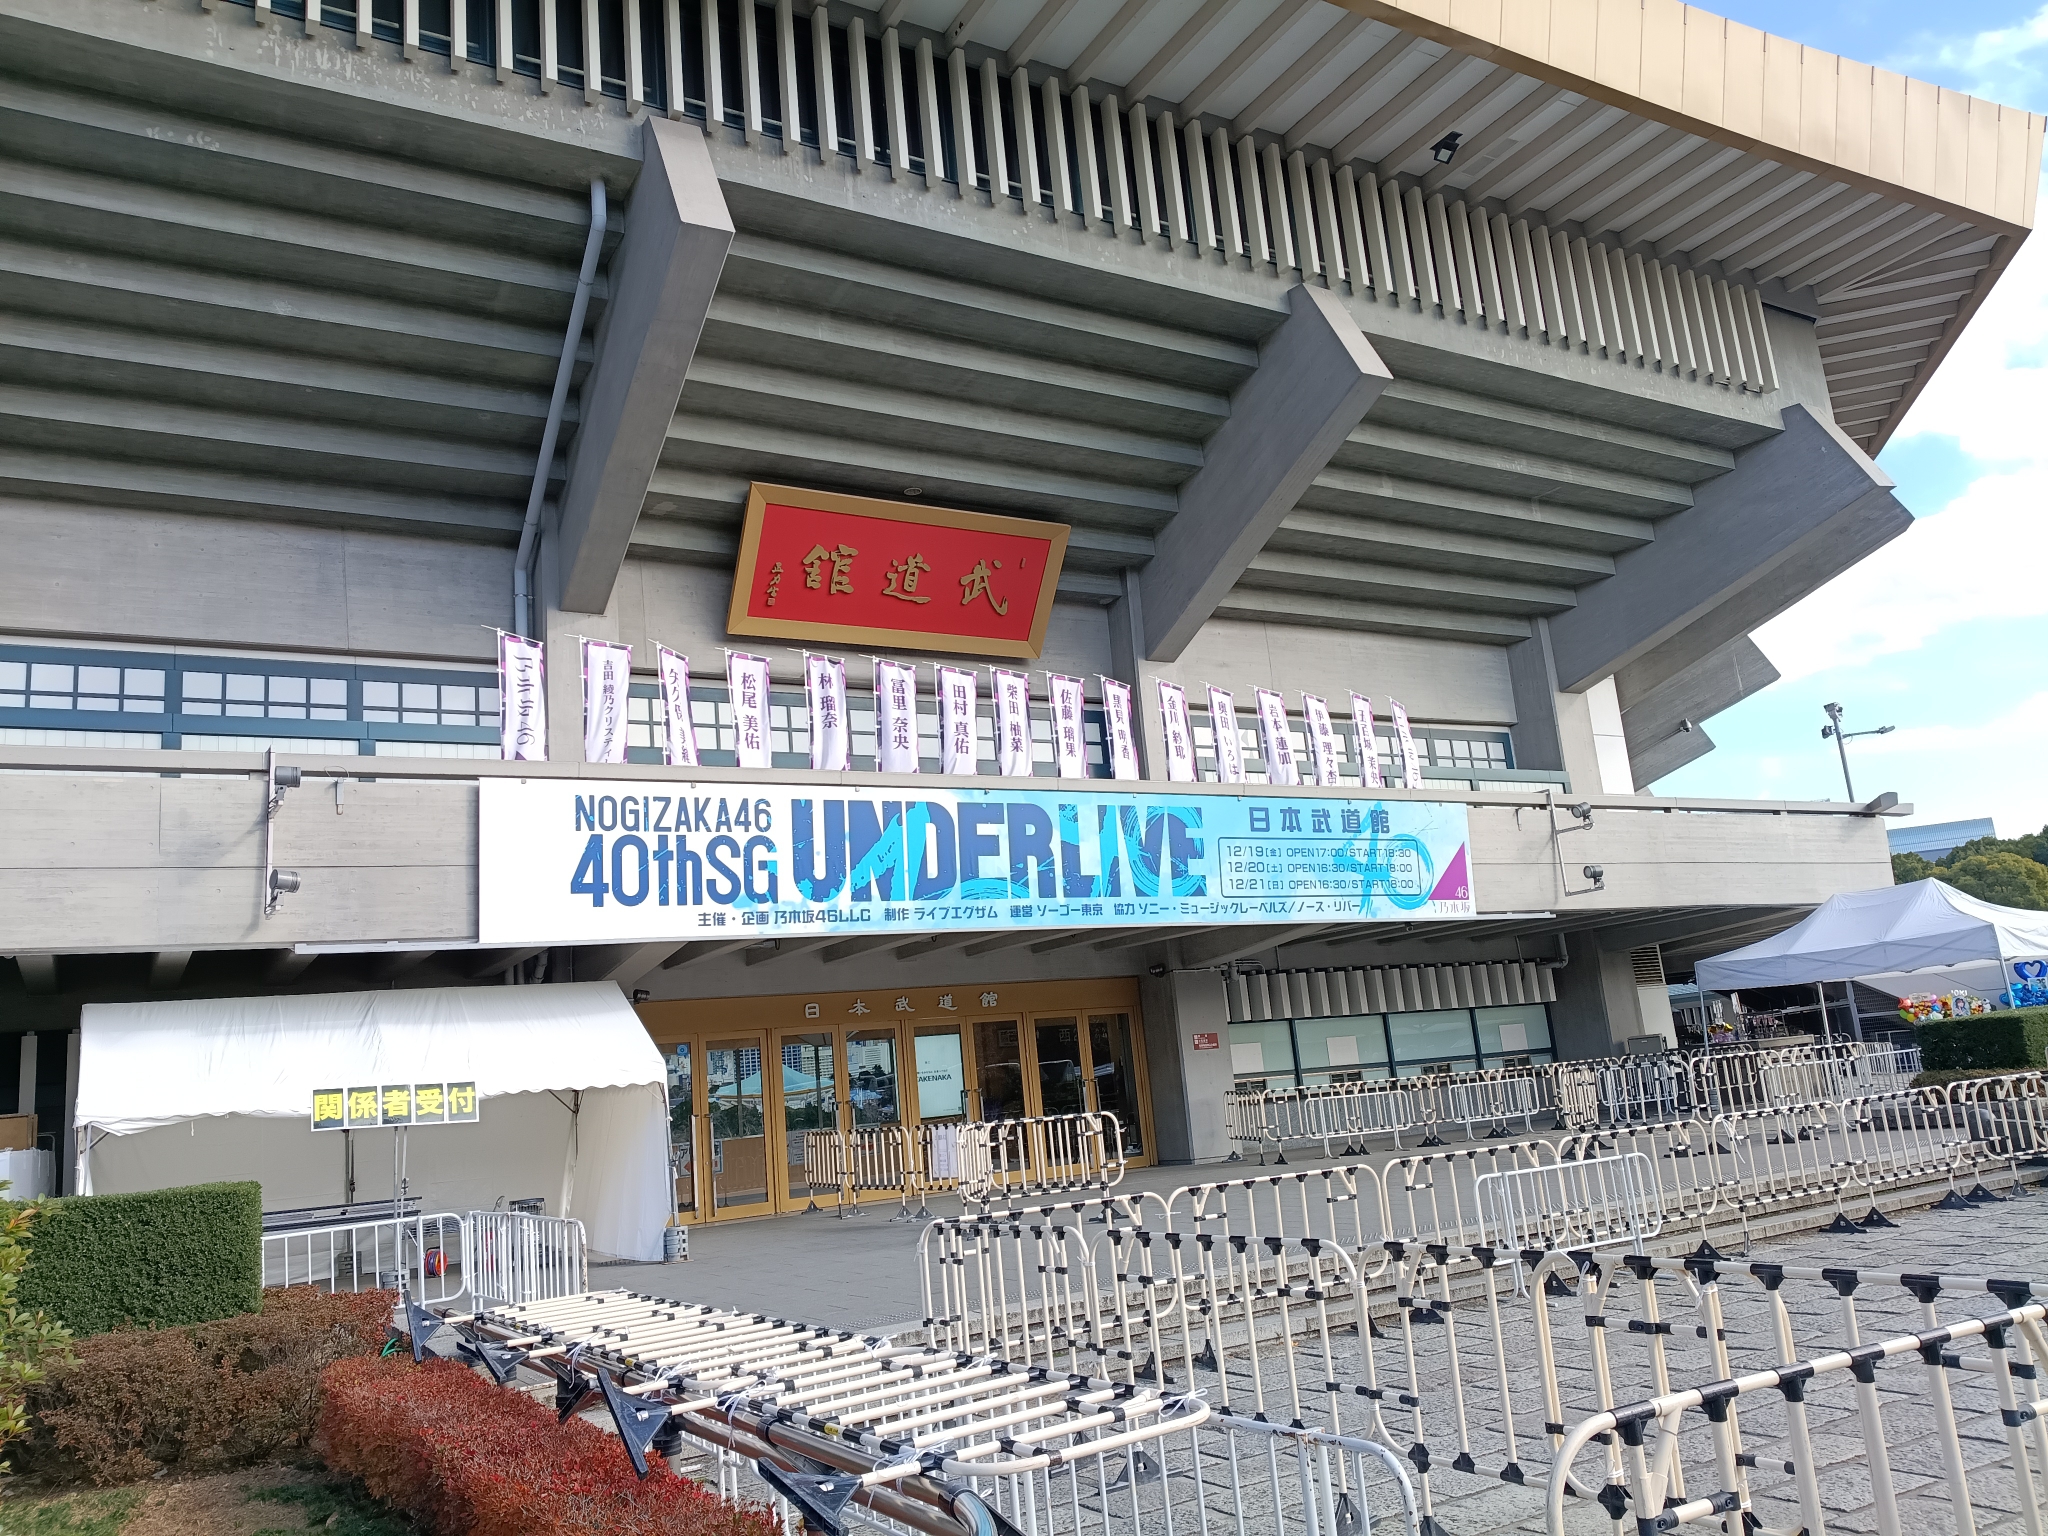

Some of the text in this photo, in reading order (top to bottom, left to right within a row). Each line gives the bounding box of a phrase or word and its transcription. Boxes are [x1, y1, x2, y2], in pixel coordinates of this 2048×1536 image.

[803, 544, 1008, 616] 武道館
[741, 672, 760, 750] 松尾 美佑
[818, 673, 838, 729] 林 瑠奈
[953, 684, 969, 754] 田村 真佑
[1007, 684, 1023, 752] 柴田 柚菜
[1060, 689, 1073, 721] 佐藤
[892, 717, 909, 750] 奈央
[1269, 704, 1291, 765] 岩本 蓮加
[1224, 735, 1240, 775] いろは
[574, 794, 773, 833] NOGIZAKA46
[1249, 806, 1390, 834] 日本武道館
[1454, 885, 1468, 899] 46
[774, 908, 871, 925] 乃木坂46LLC
[884, 907, 909, 921] 制作
[1010, 904, 1033, 918] 運営
[1037, 903, 1103, 917] ソーゴー東京
[1113, 902, 1136, 916] 協力
[804, 992, 998, 1019] 日本武道館
[916, 1073, 952, 1083] AKENAKA
[313, 1086, 476, 1122] 関係者受付
